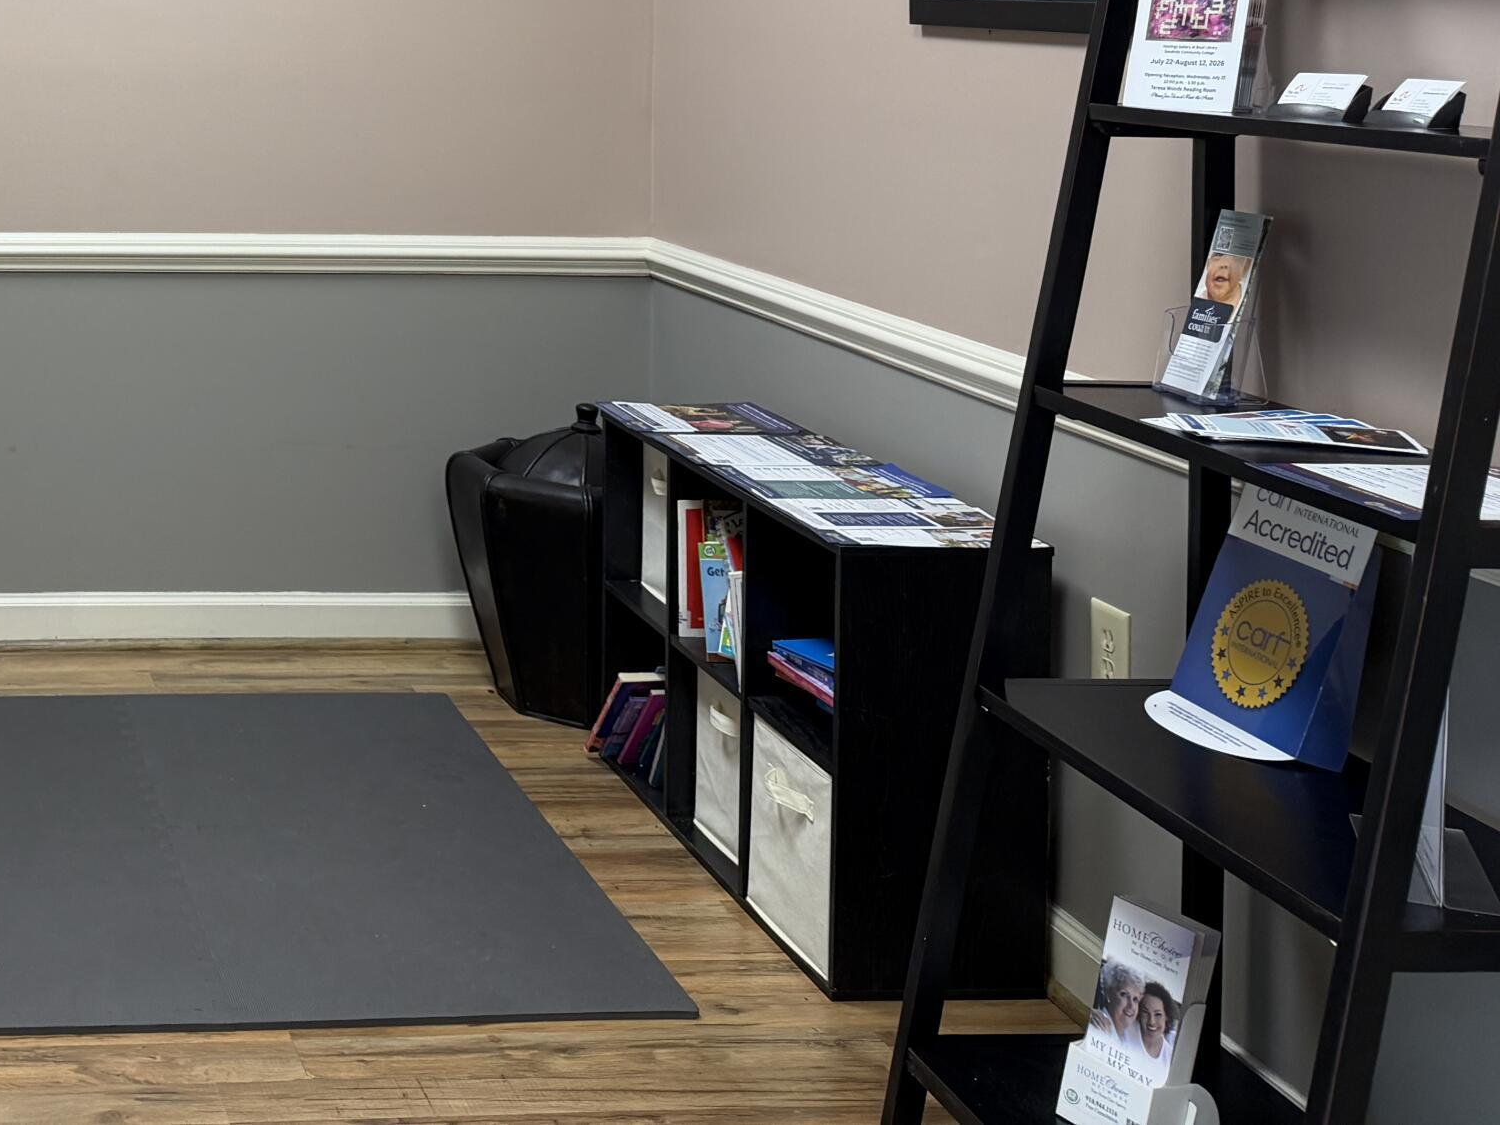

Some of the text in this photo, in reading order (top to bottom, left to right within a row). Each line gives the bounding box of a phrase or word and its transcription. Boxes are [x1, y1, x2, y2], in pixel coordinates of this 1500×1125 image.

[1198, 59, 1208, 67] 12,
[1192, 309, 1219, 323] families
[1294, 505, 1360, 538] INTERNATIONAL
[1243, 509, 1356, 570] Accredited
[1228, 587, 1301, 648] ASPIRE to Excellence
[1236, 620, 1291, 655] carf
[1113, 919, 1182, 957] HOME Choice
[1132, 940, 1180, 966] NETWORK
[1090, 1036, 1131, 1067] MY LIFE
[1076, 1063, 1105, 1085] HOME
[1107, 1057, 1153, 1087] MY WAY
